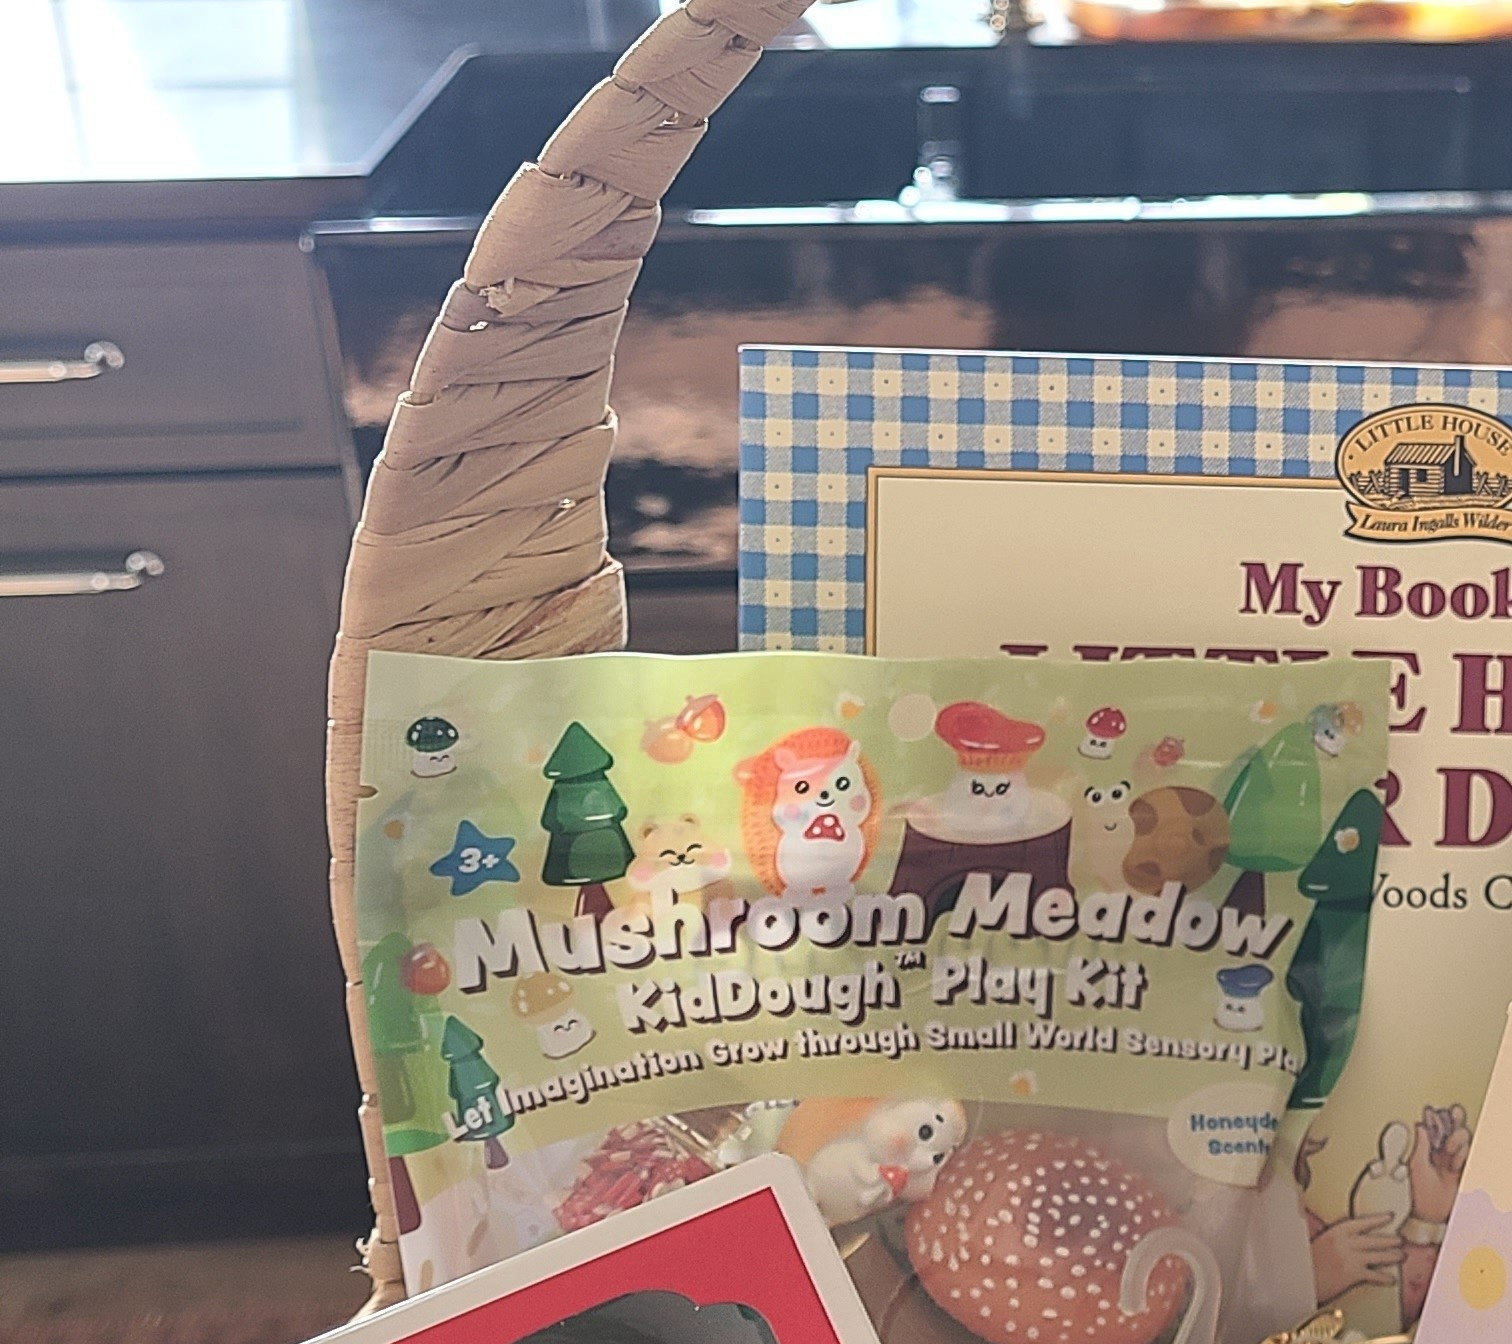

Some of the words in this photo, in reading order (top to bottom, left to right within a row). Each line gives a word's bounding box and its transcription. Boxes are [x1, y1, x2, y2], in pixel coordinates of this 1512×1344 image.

[1355, 414, 1434, 454] LITTLE
[1360, 513, 1408, 532] Laura
[1411, 512, 1460, 534] Ingalls
[1462, 512, 1512, 532] Wilder
[1239, 561, 1342, 625] My
[457, 847, 501, 875] 3+
[453, 886, 930, 995] Mushroom
[948, 871, 1294, 960] Meadow
[930, 957, 1054, 1020] Play
[1065, 957, 1150, 1009] Kit
[443, 1095, 494, 1143] Let
[494, 1049, 704, 1117] Imagination
[707, 1037, 789, 1067] Grow
[796, 1022, 921, 1063] through
[925, 1019, 1017, 1051] Small
[1024, 1019, 1118, 1054] World
[1124, 1027, 1252, 1071] Sensory
